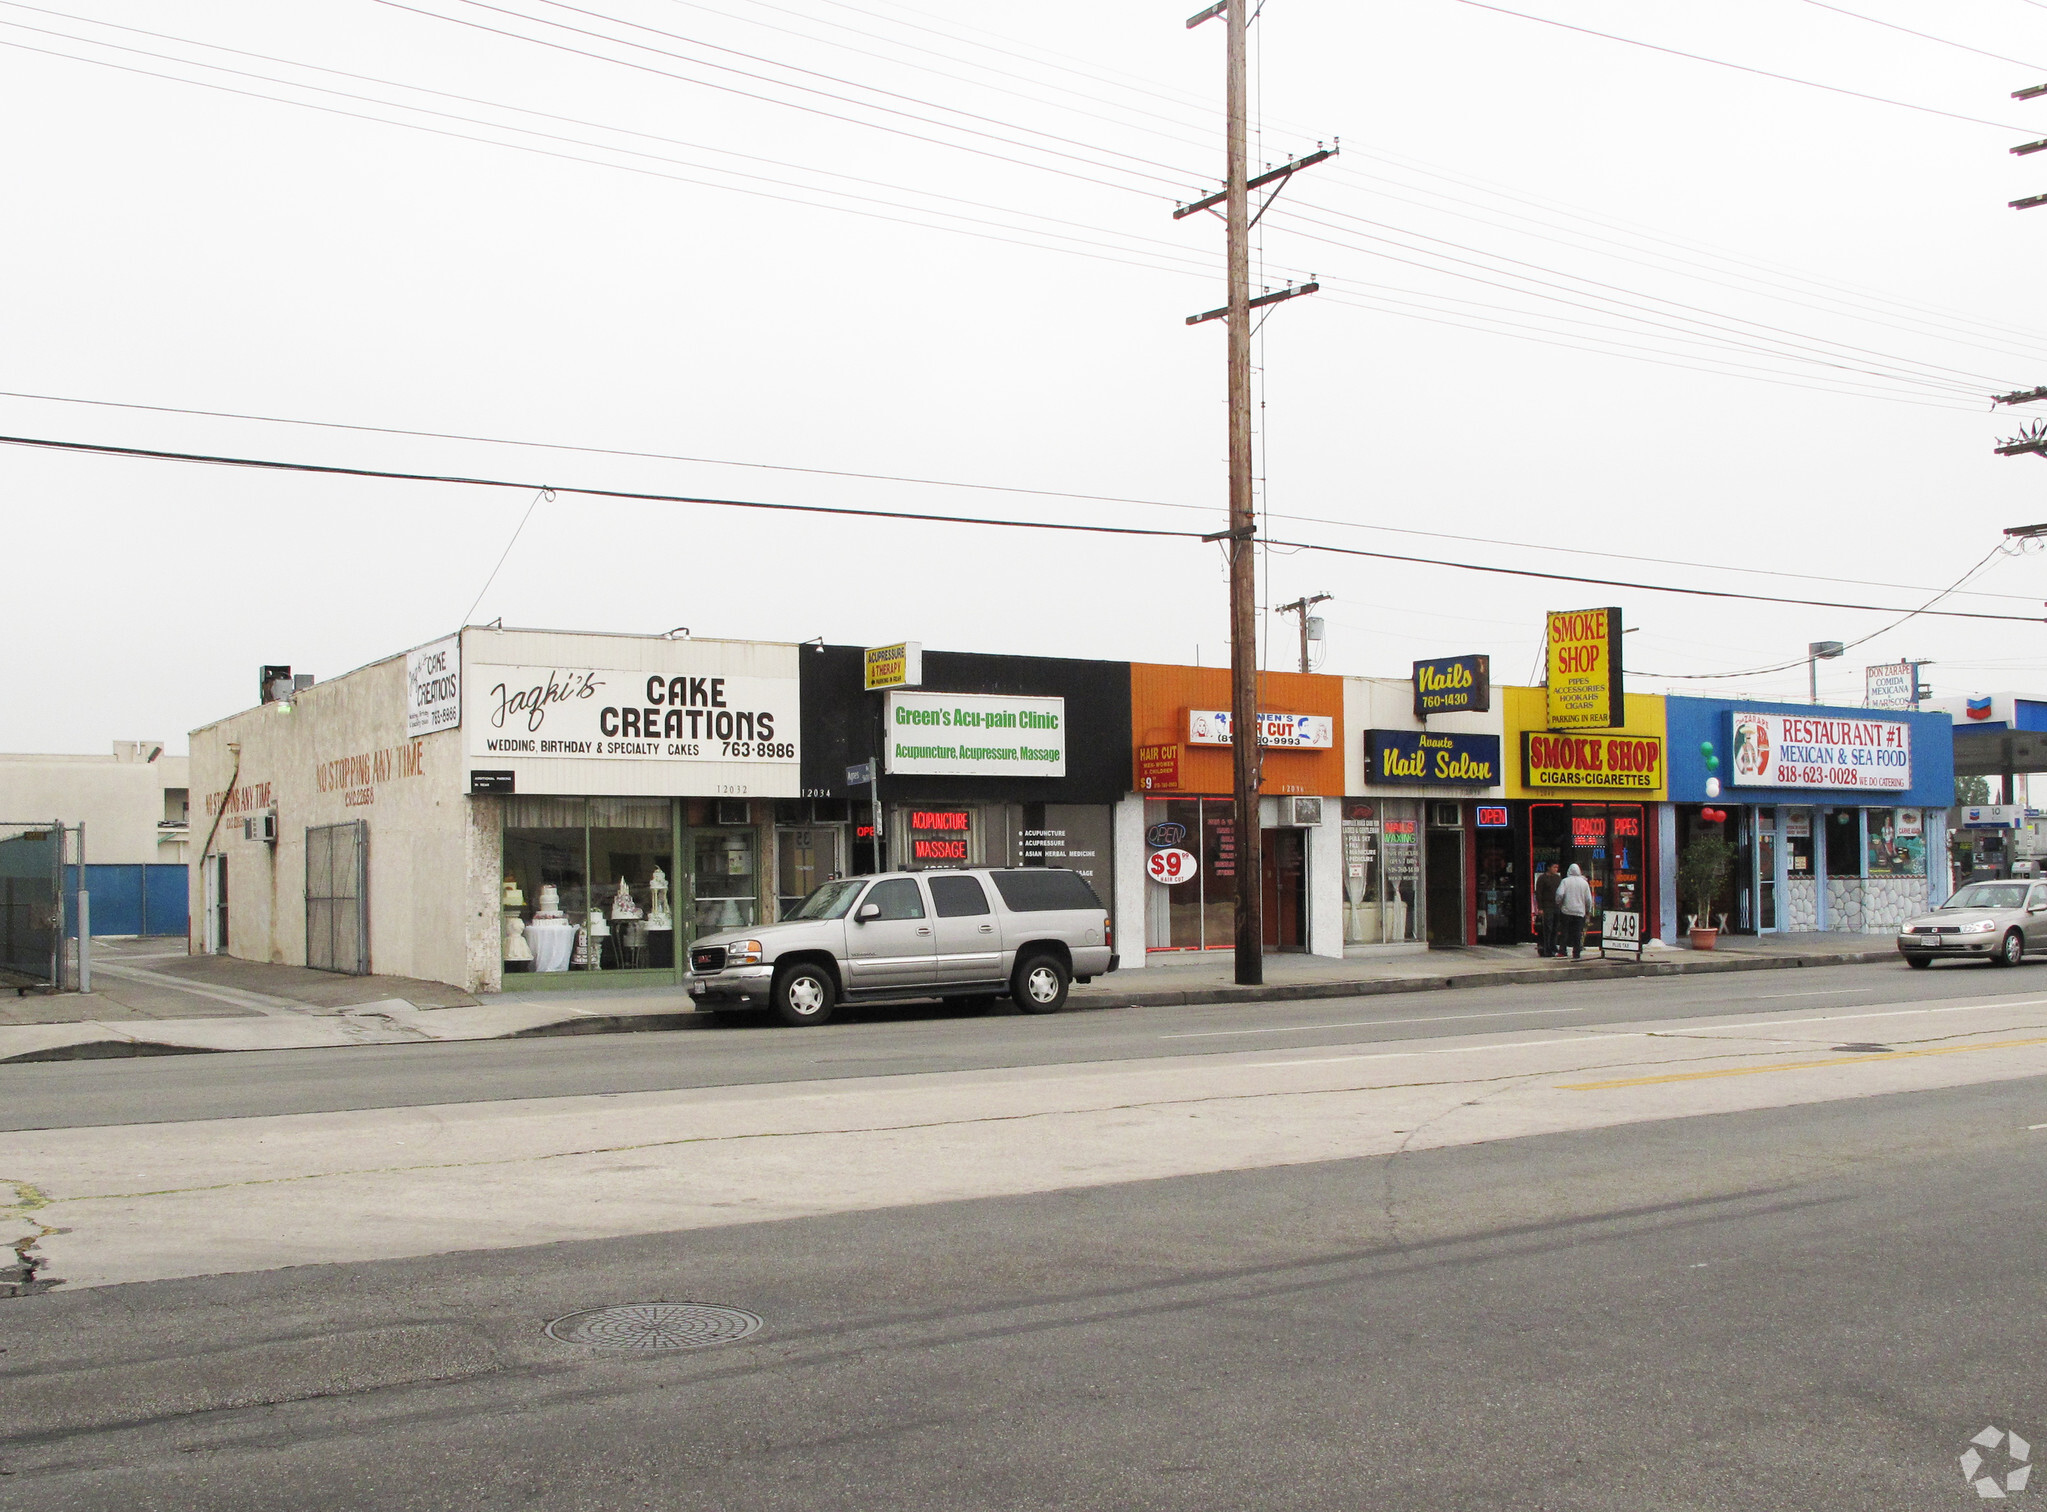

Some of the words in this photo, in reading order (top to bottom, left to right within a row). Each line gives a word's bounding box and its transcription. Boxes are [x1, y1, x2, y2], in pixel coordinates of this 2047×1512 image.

[1552, 613, 1605, 643] SMOKE
[427, 651, 446, 675] CAKE
[868, 647, 905, 664] ACUPRESSURE
[1558, 645, 1599, 674] SHOP
[876, 662, 902, 676] THERAPY
[1419, 663, 1473, 692] Nails
[1868, 668, 1884, 677] DON
[1885, 665, 1911, 676] ZARAPE
[1554, 685, 1605, 694] ACCESSORIES
[1568, 677, 1589, 685] PIPES
[1876, 677, 1904, 686] COMIDA
[417, 673, 457, 707] CREATIONS
[646, 675, 727, 708] CAKE
[1560, 693, 1598, 702] HOOKAHS
[1871, 685, 1909, 695] MEXICANA
[1422, 693, 1468, 708] 760-1430
[1565, 702, 1593, 710] CIGARS
[600, 706, 775, 741] CREATIONS
[895, 705, 951, 726] Green's
[953, 708, 1017, 729] Acu-pain
[1019, 710, 1059, 729] Clinic
[1552, 715, 1579, 723] PARKING
[1268, 723, 1294, 736] CUT
[1783, 719, 1883, 747] RESTAURANT
[1886, 726, 1903, 748] #1
[487, 739, 538, 754] WEDDING,
[541, 740, 592, 754] BIRTHDAY
[596, 742, 603, 753] &
[607, 742, 660, 755] SPECIALTY
[668, 743, 699, 756] CAKES
[1419, 734, 1454, 748] Avante
[895, 743, 958, 760] Acupuncture,
[959, 745, 1019, 762] Acupressure,
[1020, 746, 1060, 762] Massage
[1140, 747, 1158, 761] HAIR
[1162, 746, 1177, 759] CUT
[1531, 736, 1603, 771] SMOKE
[1607, 739, 1659, 772] SHOP
[1780, 745, 1833, 763] MEXICAN
[1838, 749, 1847, 765] &
[1851, 750, 1873, 766] SEA
[1876, 750, 1907, 767] FOOD
[317, 763, 327, 793] NO
[329, 753, 370, 792] STOPPING
[373, 748, 393, 784] ANY
[1383, 748, 1426, 777] Nail
[1435, 751, 1492, 779] Salon
[1778, 765, 1857, 785] 818-623-0028
[1859, 777, 1868, 786] WE
[1869, 777, 1878, 786] DO
[1879, 778, 1904, 787] CATERING
[241, 786, 254, 811] ANY
[255, 781, 271, 809] TIME
[717, 785, 748, 794] 12032
[802, 789, 831, 798] 12034
[912, 812, 968, 830] ACUPUNCTURE
[1480, 809, 1506, 824] OPEN
[857, 826, 876, 837] OPE
[1147, 826, 1183, 843] OPEN
[1385, 822, 1414, 833] NAILS
[1572, 818, 1606, 835] TOBACCO
[1614, 818, 1639, 835] PIPES
[915, 841, 967, 858] MASSAGE
[1151, 852, 1182, 877] $9
